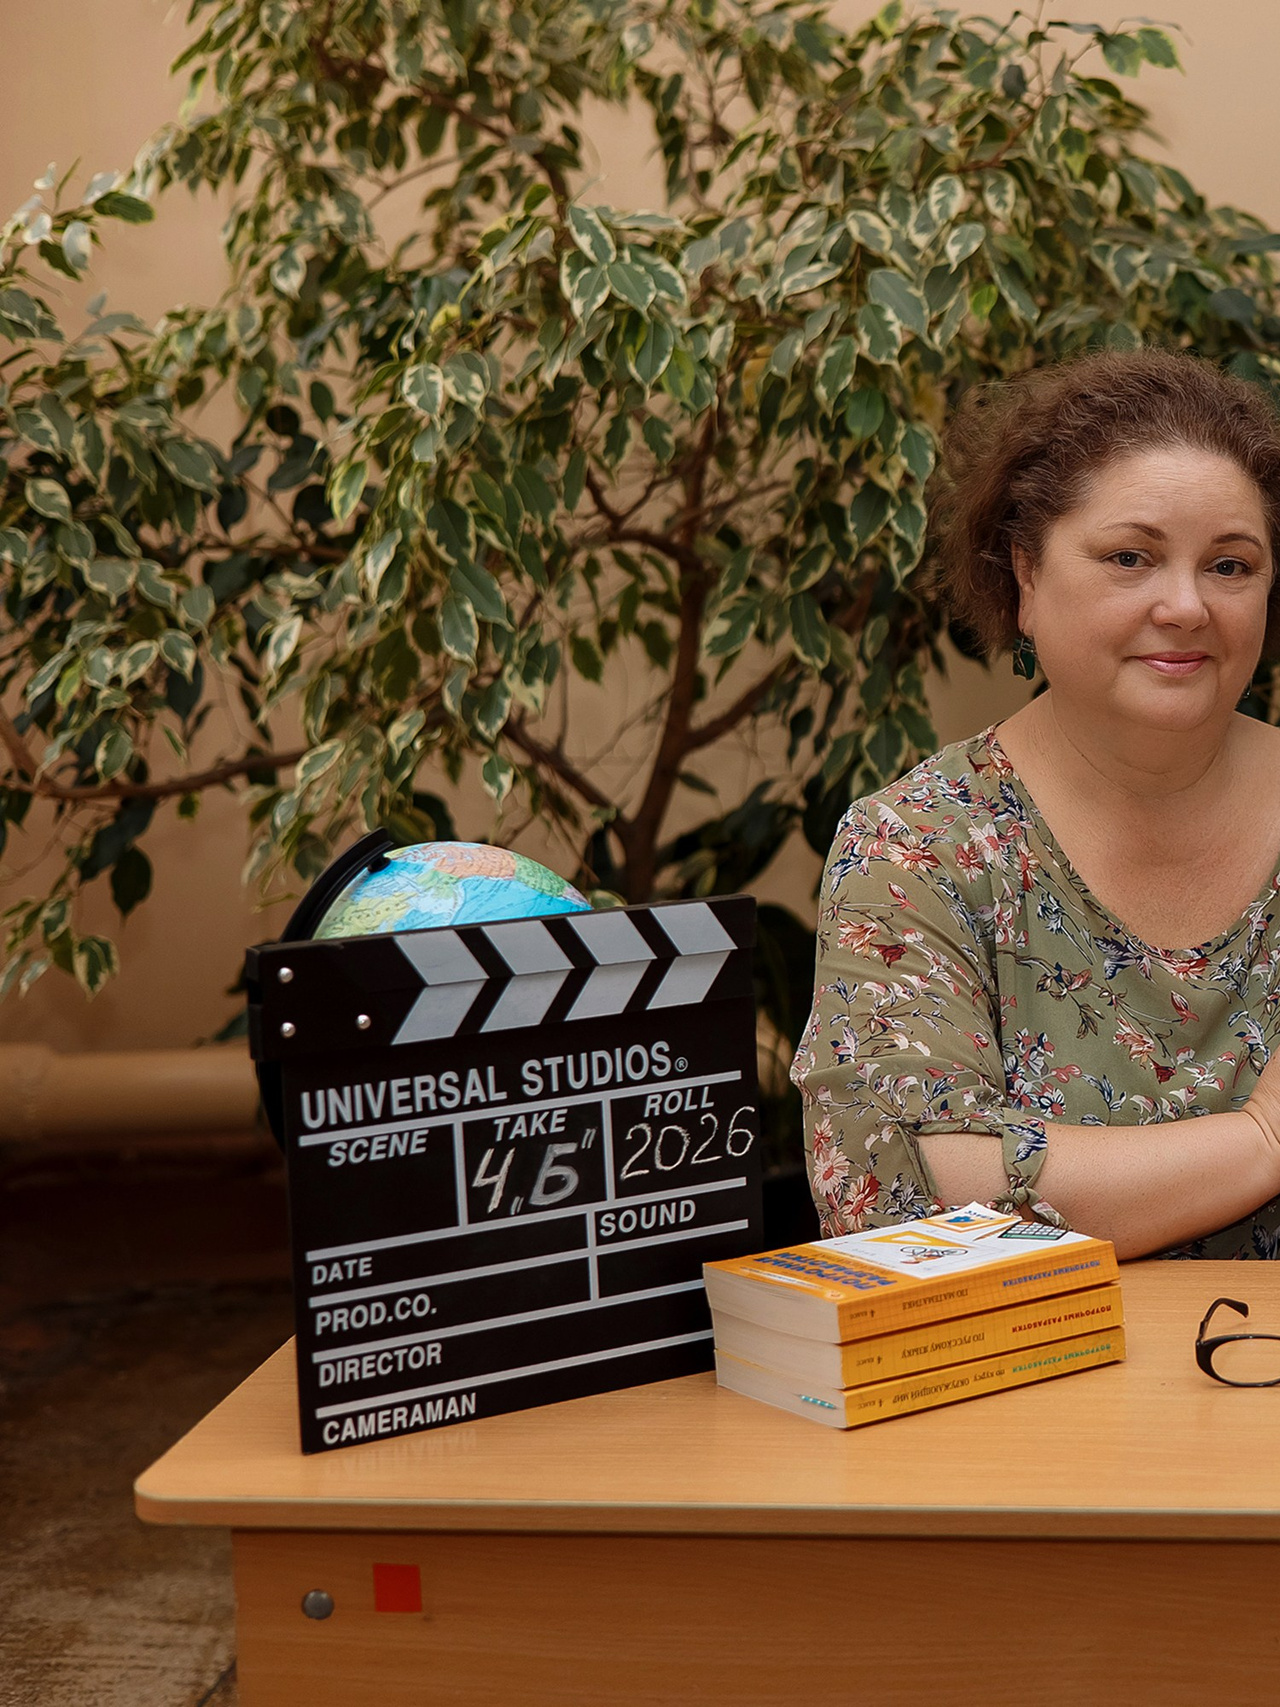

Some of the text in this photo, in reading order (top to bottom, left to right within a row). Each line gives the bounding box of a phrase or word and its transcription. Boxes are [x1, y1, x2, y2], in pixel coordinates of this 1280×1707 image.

[302, 1065, 507, 1129] UNIVERSAL
[644, 1086, 715, 1118] ROLL
[493, 1109, 567, 1142] TAKE
[328, 1129, 428, 1168] SCENE
[620, 1105, 756, 1181] 2026
[600, 1200, 696, 1237] SOUND
[312, 1257, 373, 1286] DATE
[1053, 1259, 1100, 1276] ПОУРОЧНЫЕ
[1002, 1270, 1052, 1287] РАЗРАБОТКИ
[902, 1291, 955, 1310] МАТЕМАТИКЕ
[956, 1288, 968, 1298] ПО
[315, 1294, 437, 1336] PROD.CO.
[1063, 1304, 1112, 1322] ПОУРОЧНЫЕ
[1011, 1316, 1062, 1333] РАЗРАБОТКИ
[929, 1333, 972, 1352] РУССКОМУ
[972, 1332, 985, 1342] ПО
[901, 1344, 929, 1359] ЯЗЫКУ
[1063, 1344, 1111, 1360] ПОУРОЧНЫЕ
[318, 1343, 442, 1388] DIRECTOR
[1012, 1356, 1062, 1373] РАЗРАБОТКИ
[892, 1391, 910, 1403] МИР
[911, 1377, 970, 1400] ОКРУЖАЮЩИЙ
[322, 1393, 476, 1446] CAMERAMAN
